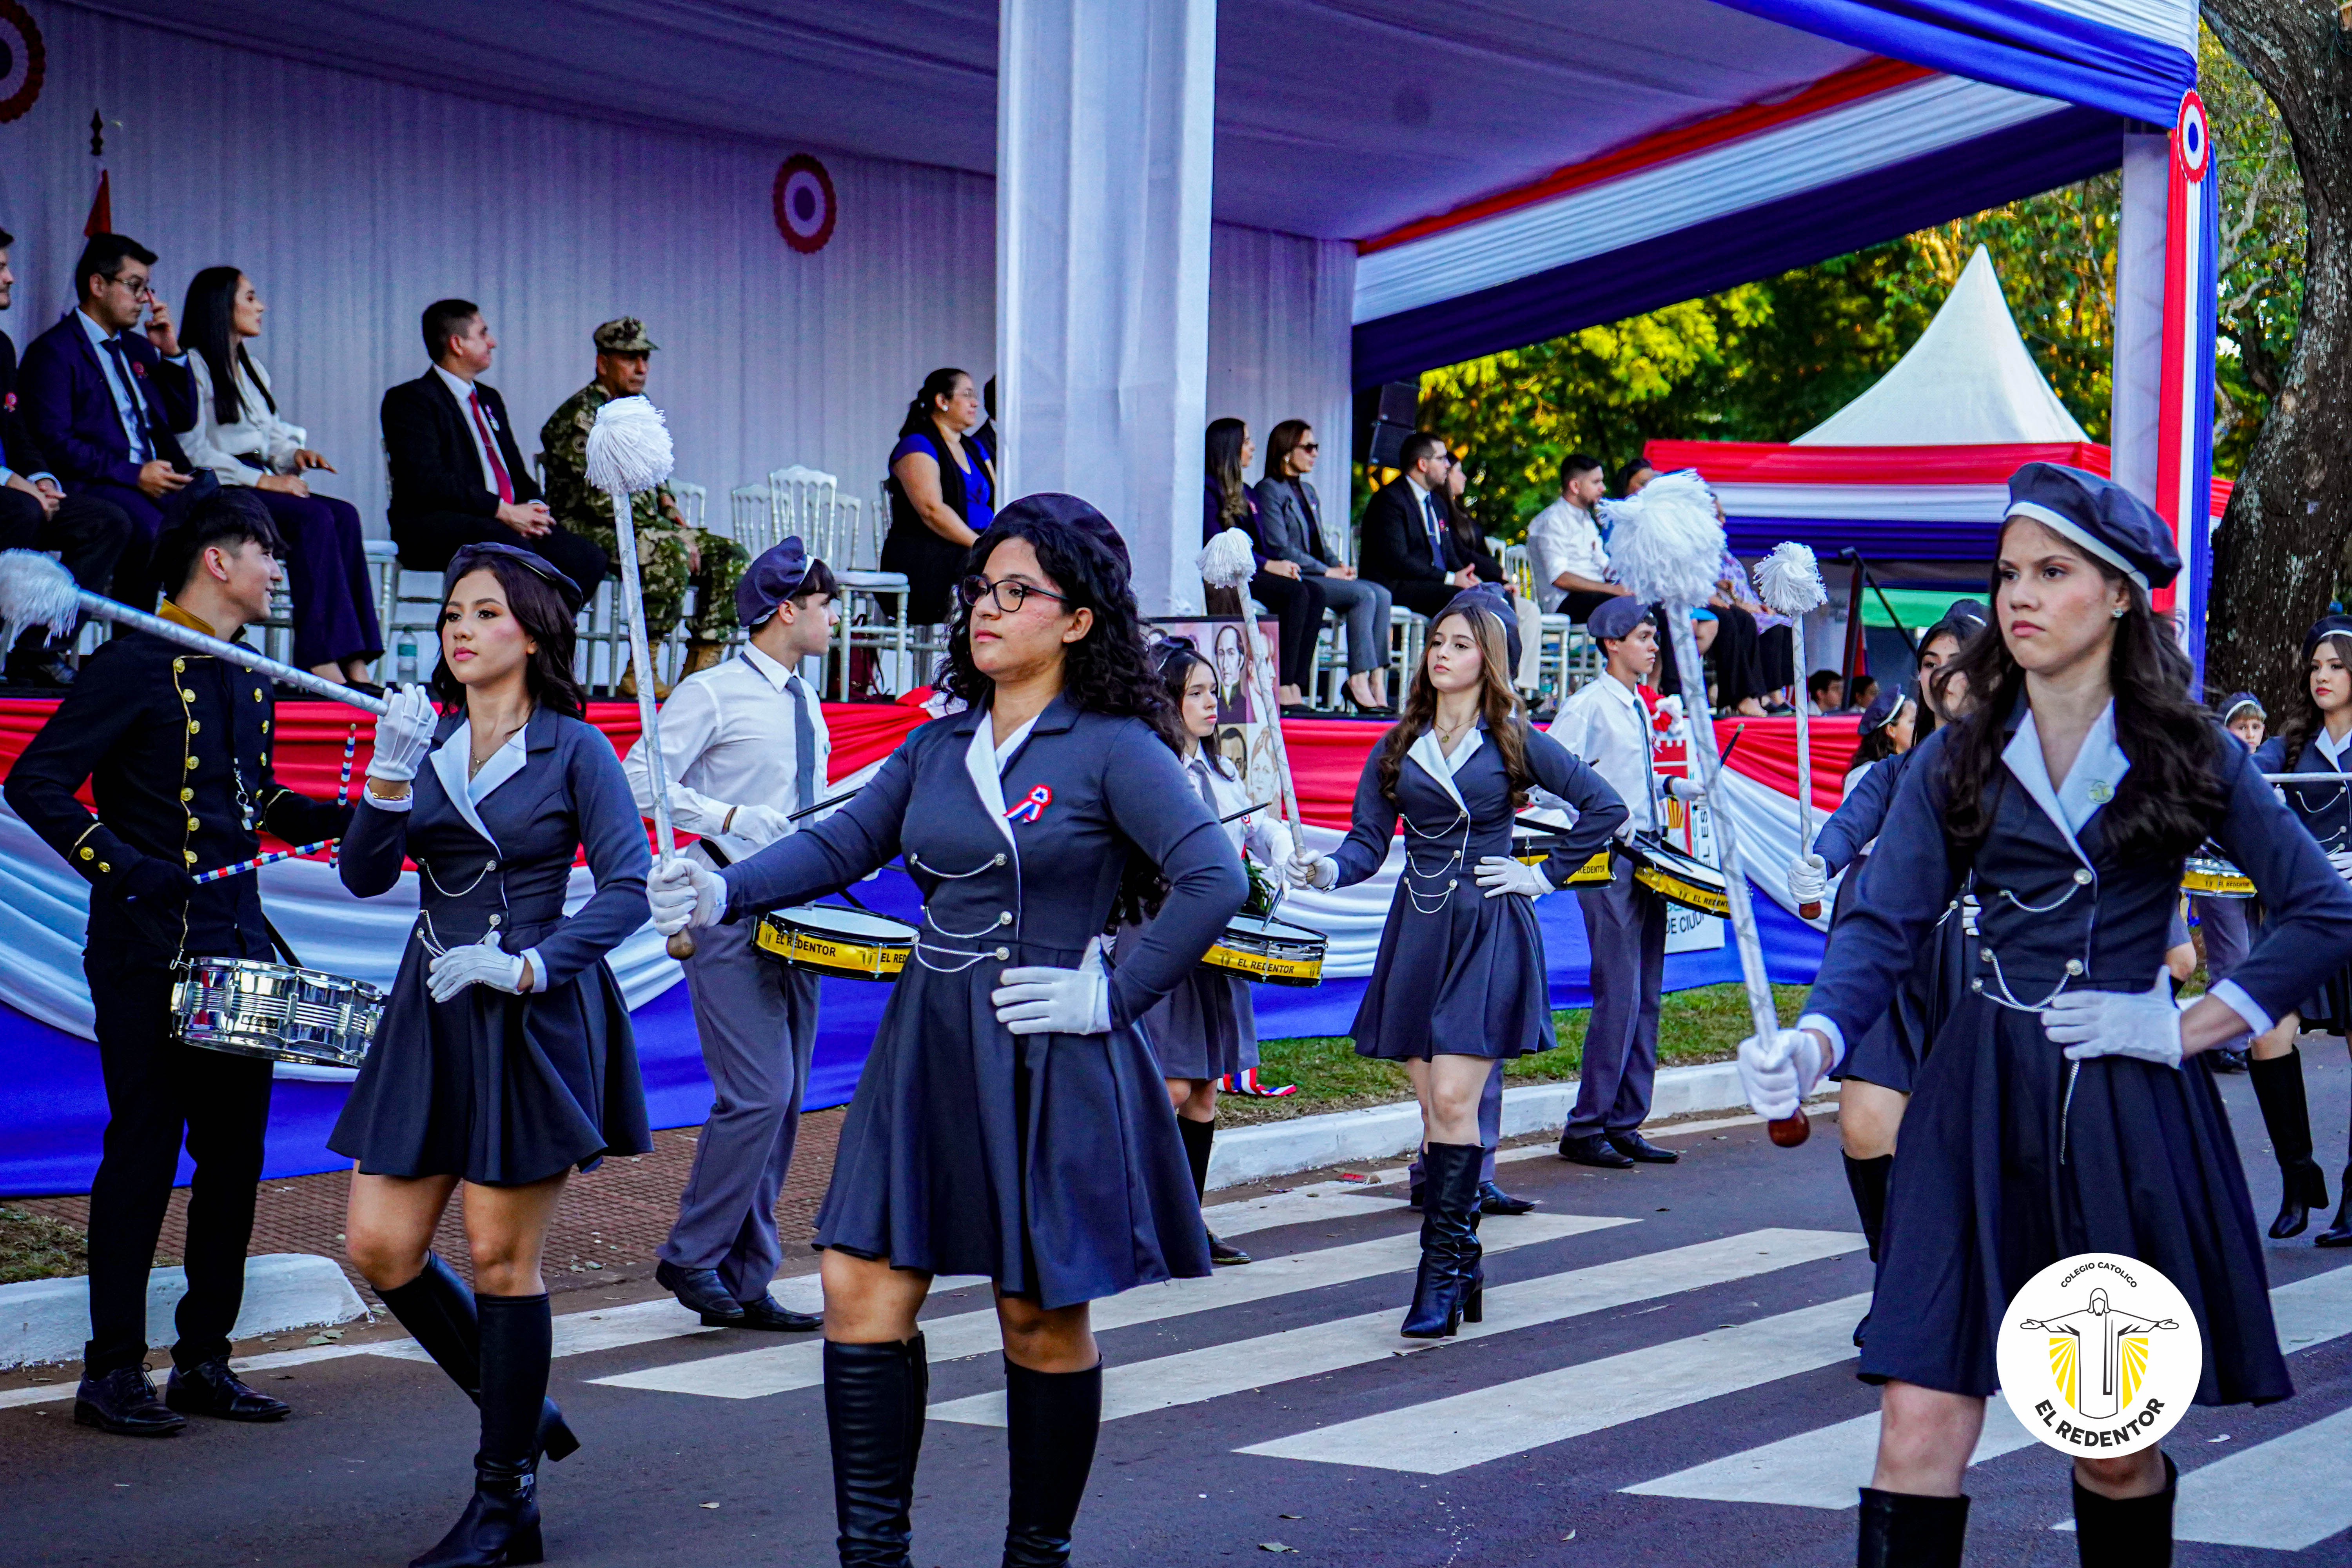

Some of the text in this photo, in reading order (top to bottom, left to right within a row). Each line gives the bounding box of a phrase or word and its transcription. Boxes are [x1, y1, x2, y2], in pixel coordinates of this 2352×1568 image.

[1693, 895, 1729, 907] EL REDENT
[1680, 911, 1704, 933] CIUD
[776, 934, 784, 945] EL
[880, 953, 907, 964] EL RED
[1237, 958, 1294, 974] EL REDENTOR
